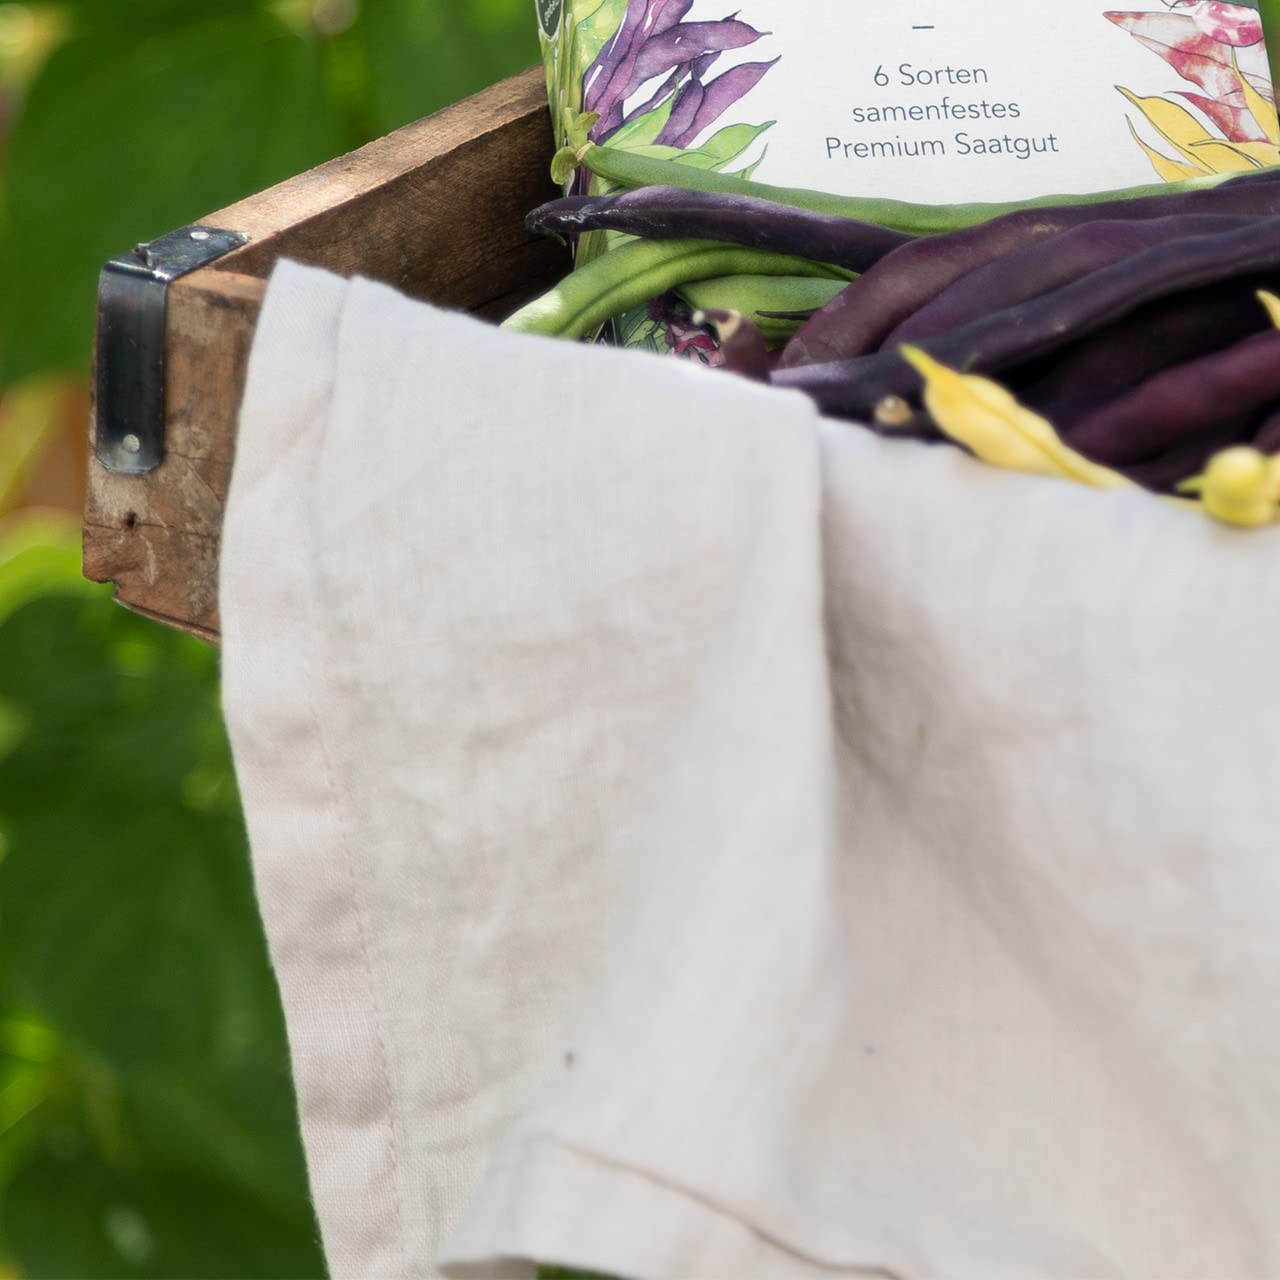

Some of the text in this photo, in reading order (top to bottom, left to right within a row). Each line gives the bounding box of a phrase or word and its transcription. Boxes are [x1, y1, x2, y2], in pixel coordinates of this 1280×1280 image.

[873, 63, 989, 87] 6 Sorten
[852, 95, 1021, 124] samenfestes
[825, 131, 1060, 160] Premium Saatgut
